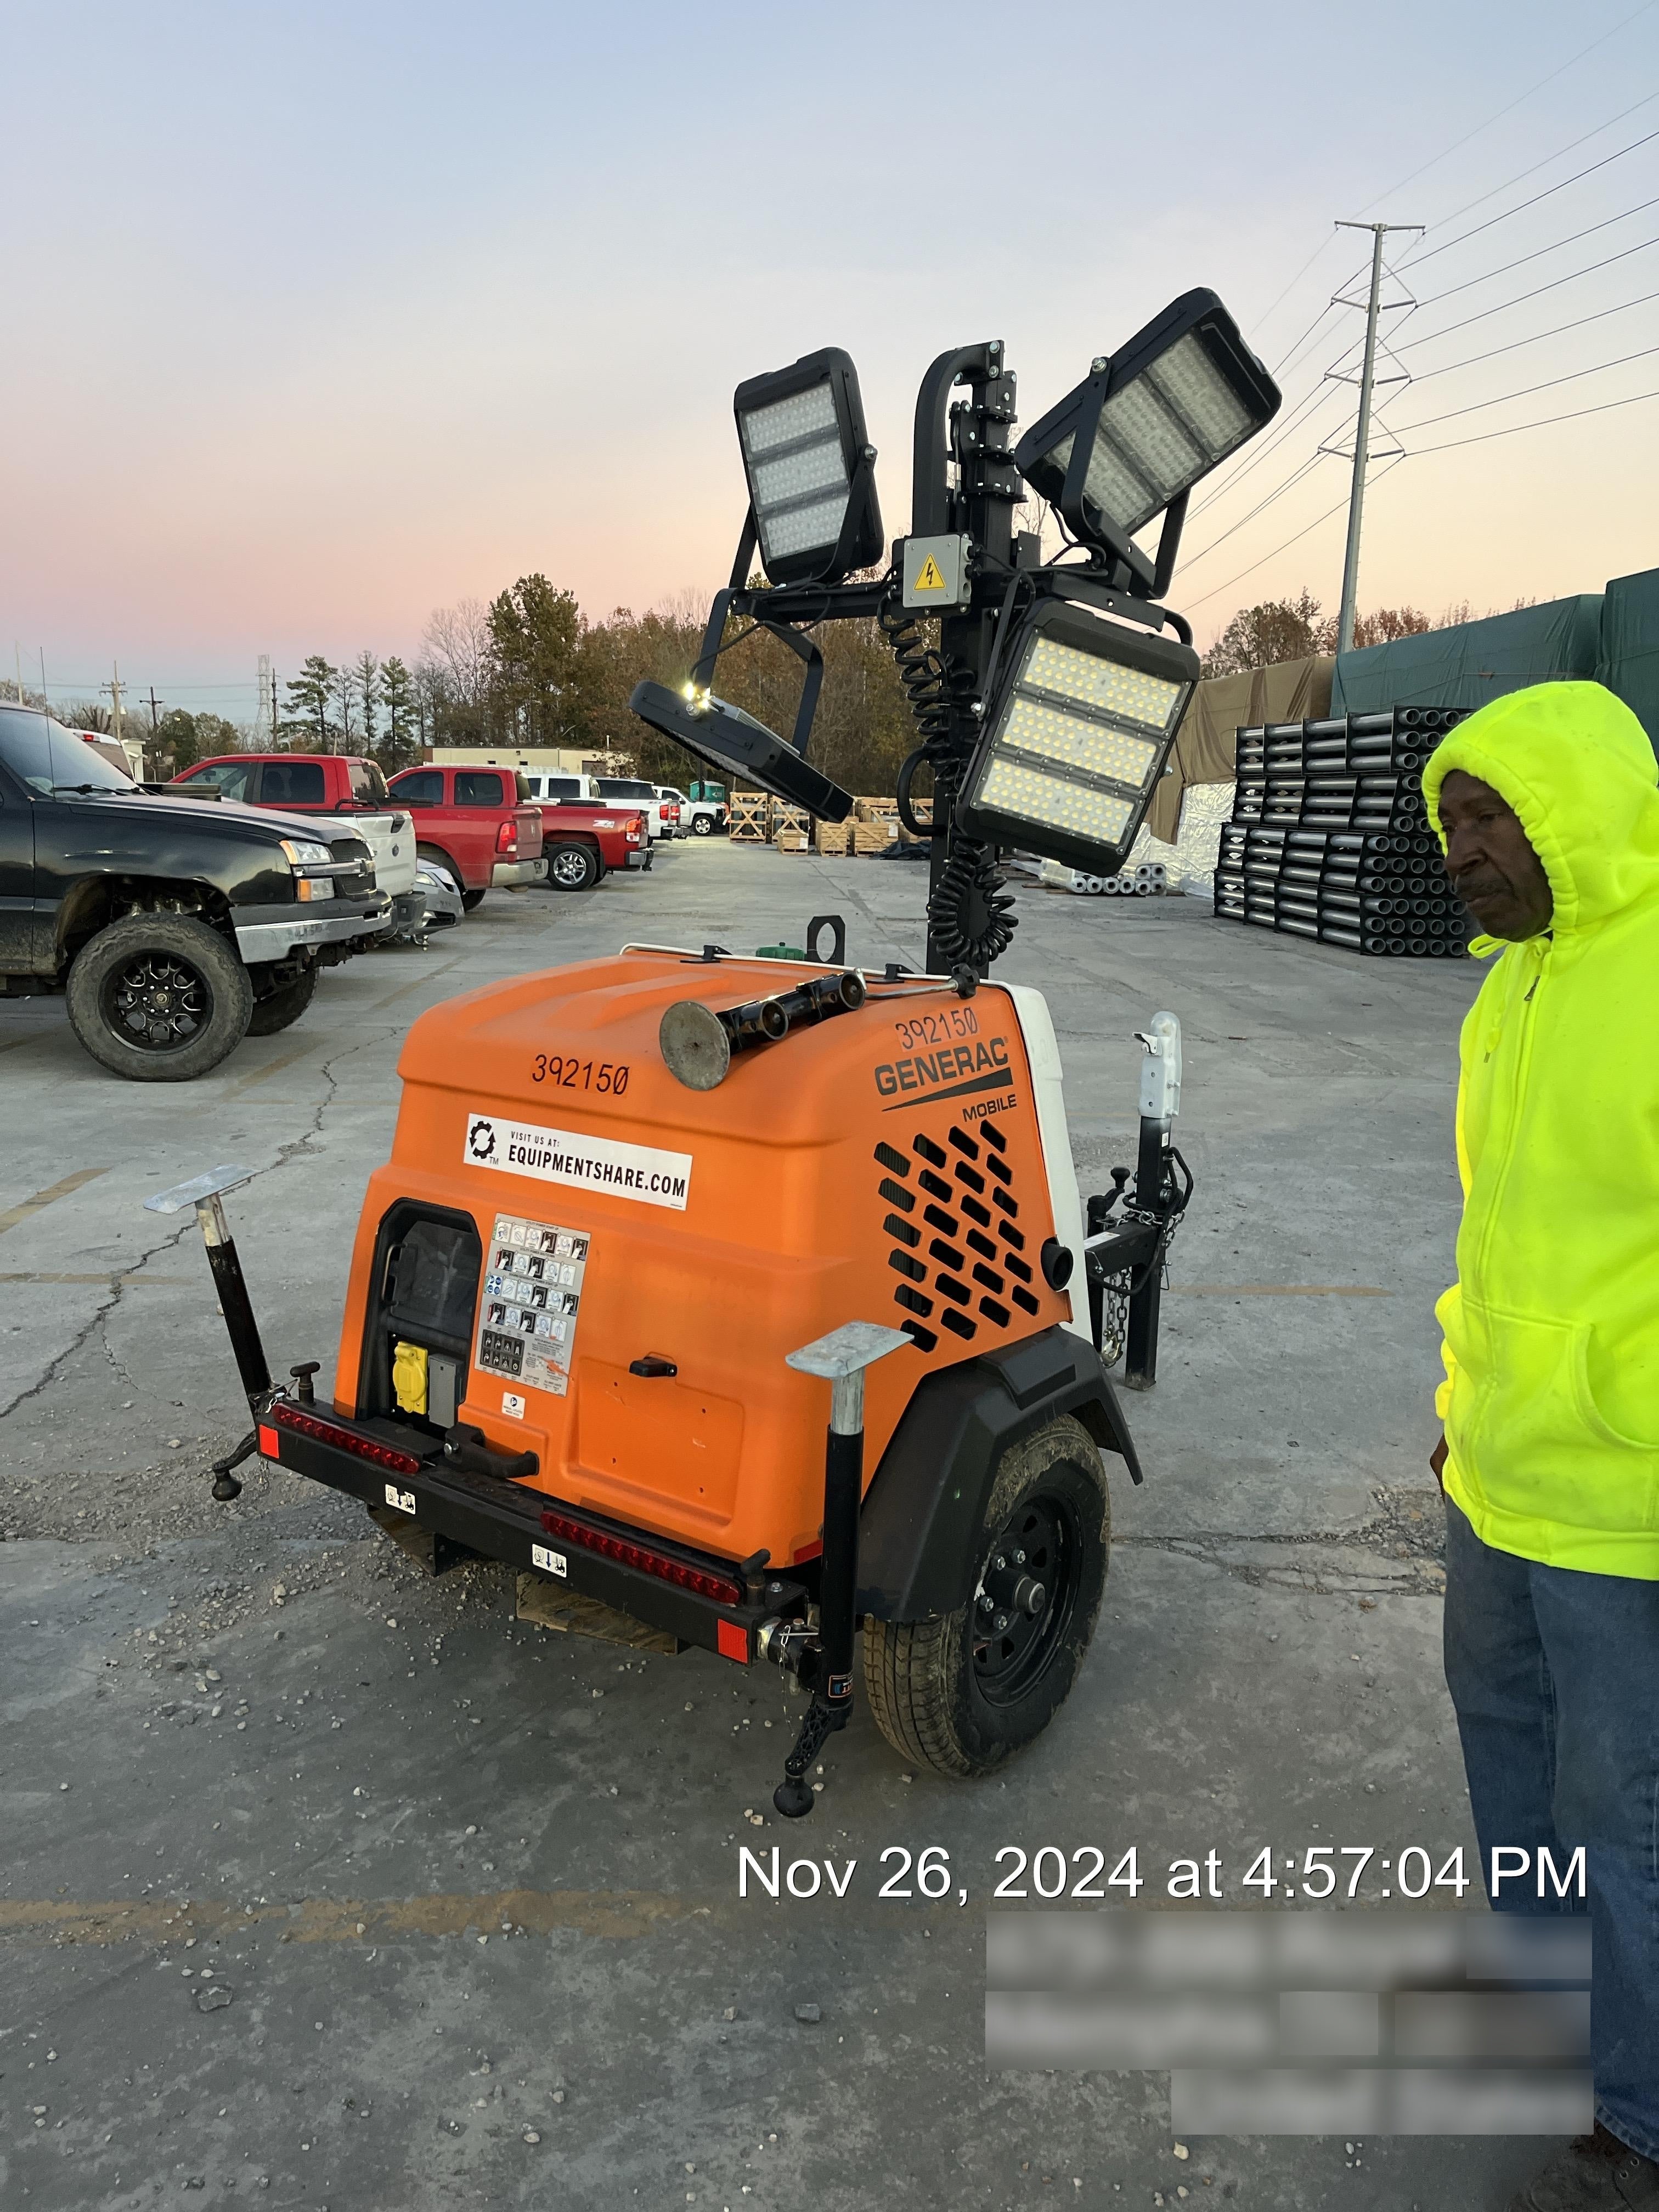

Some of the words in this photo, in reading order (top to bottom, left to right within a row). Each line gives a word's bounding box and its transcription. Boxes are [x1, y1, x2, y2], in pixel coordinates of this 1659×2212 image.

[895, 1006, 978, 1049] 392150
[532, 1054, 630, 1095] 392150
[874, 1037, 1008, 1096] GENERAC
[962, 1094, 1017, 1122] MOBILE
[511, 1131, 531, 1142] VISIT
[535, 1136, 544, 1145] US
[548, 1138, 560, 1147] AT:
[508, 1144, 686, 1198] EQUIPMENTSHARE.COM
